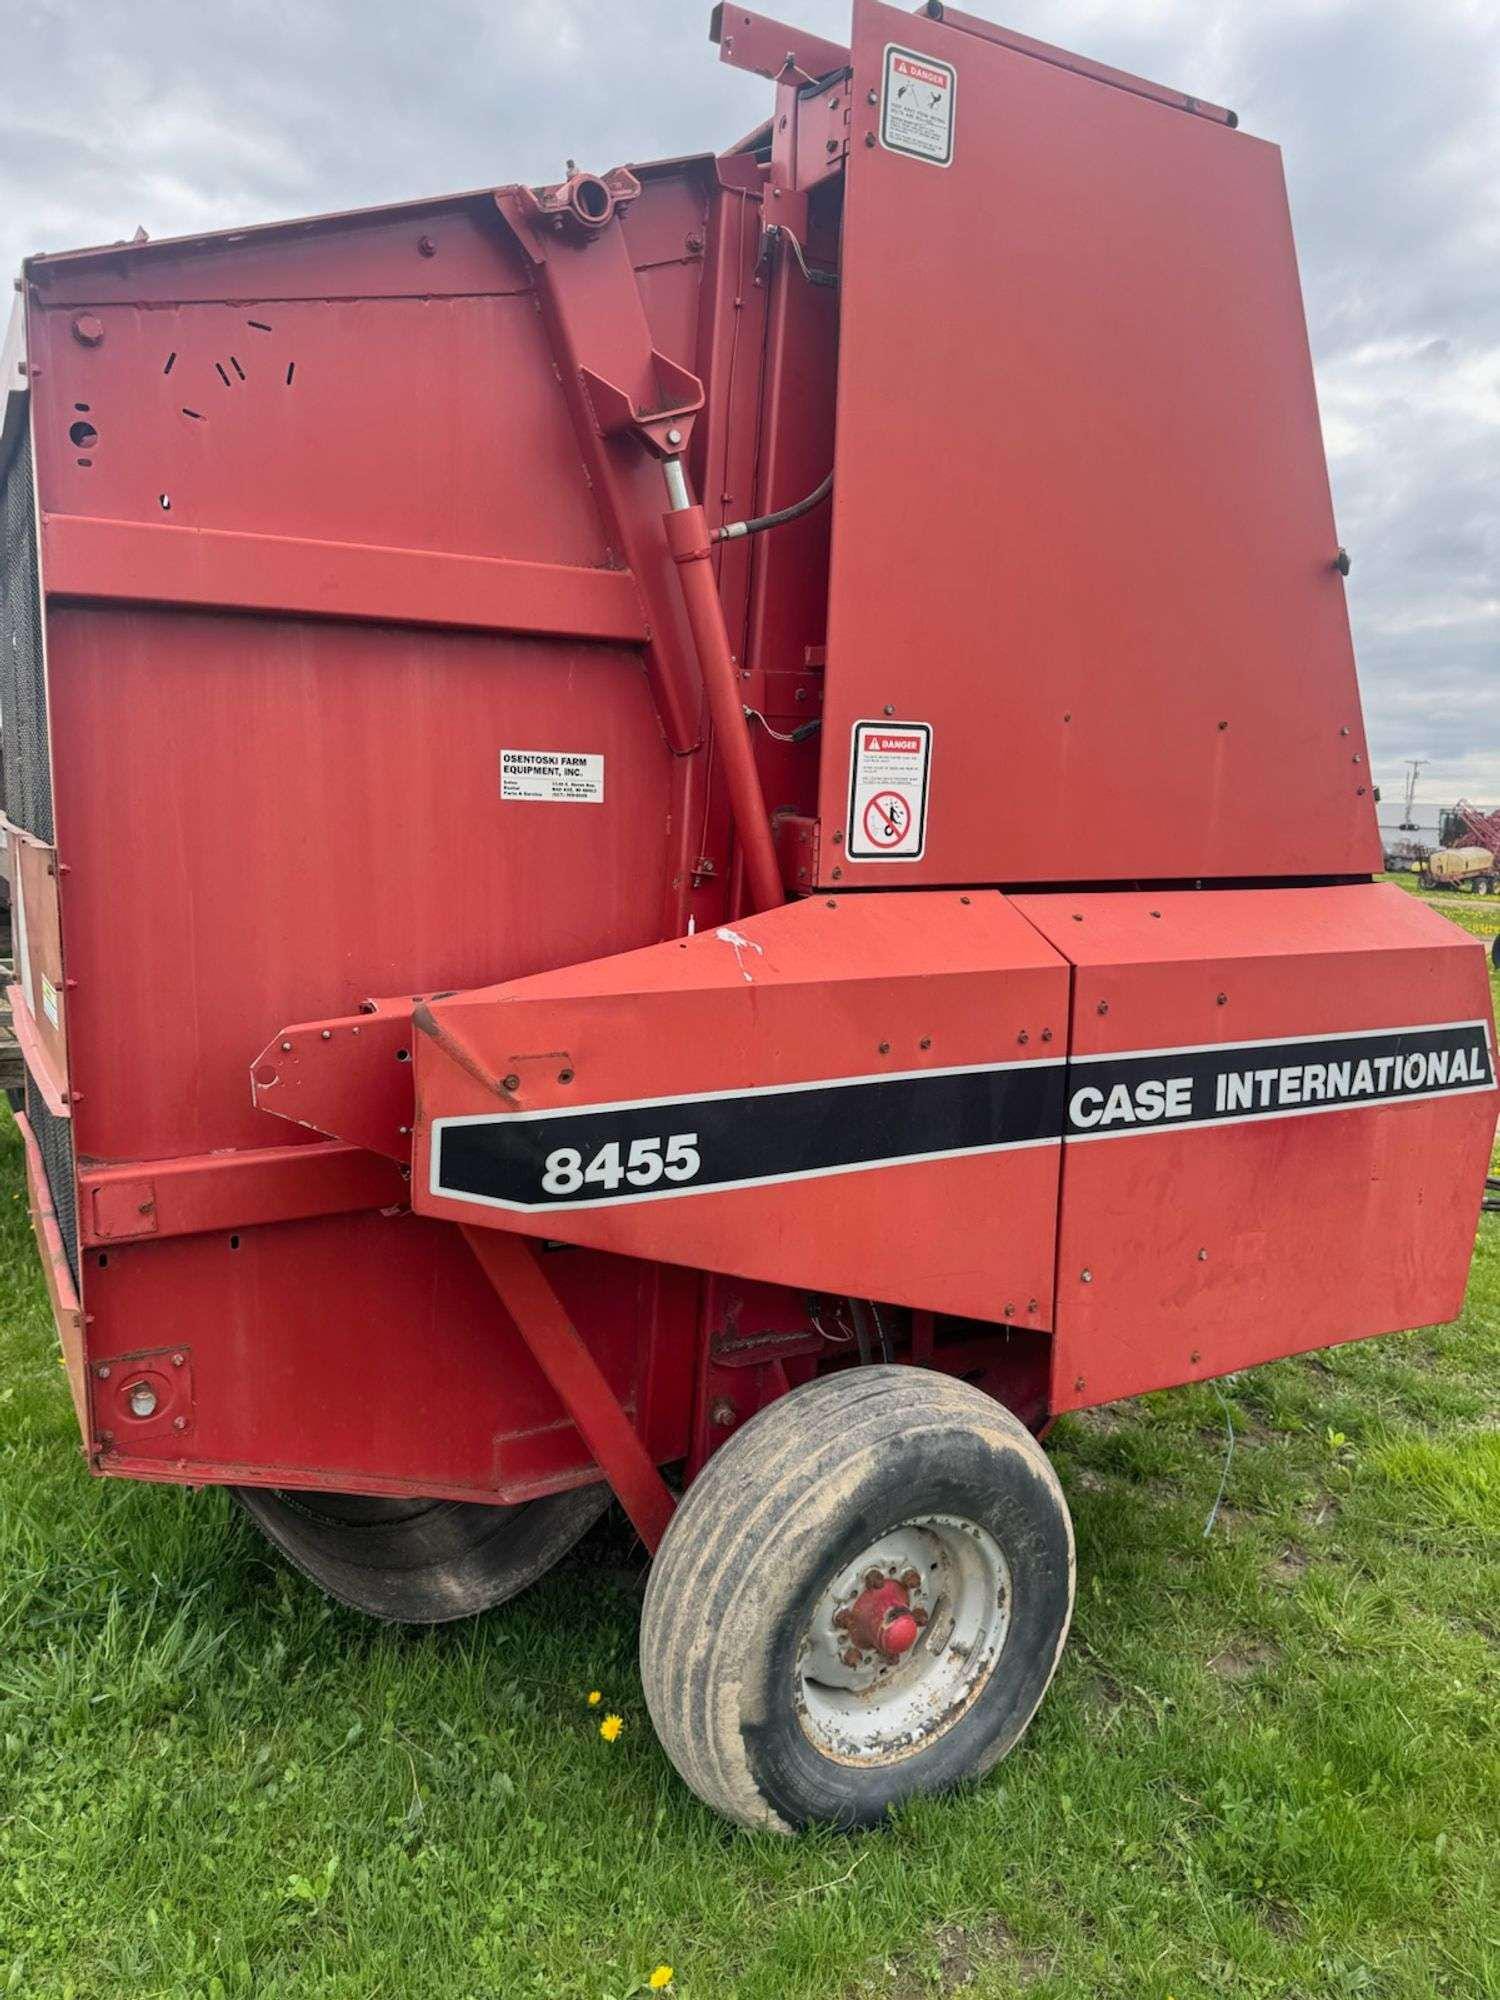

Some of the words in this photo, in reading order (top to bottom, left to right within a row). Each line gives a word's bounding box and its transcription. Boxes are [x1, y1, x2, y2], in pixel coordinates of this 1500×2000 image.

[910, 66, 944, 86] DANGER
[881, 739, 917, 749] DANGER
[503, 754, 558, 765] OSENTOSKI
[561, 757, 587, 766] FARM
[503, 765, 561, 776] EQUIPMENT,
[564, 767, 583, 777] INC.
[1069, 1077, 1193, 1128] CASE
[1215, 1047, 1486, 1112] INTERNATIONAL
[541, 1133, 700, 1195] 8455
